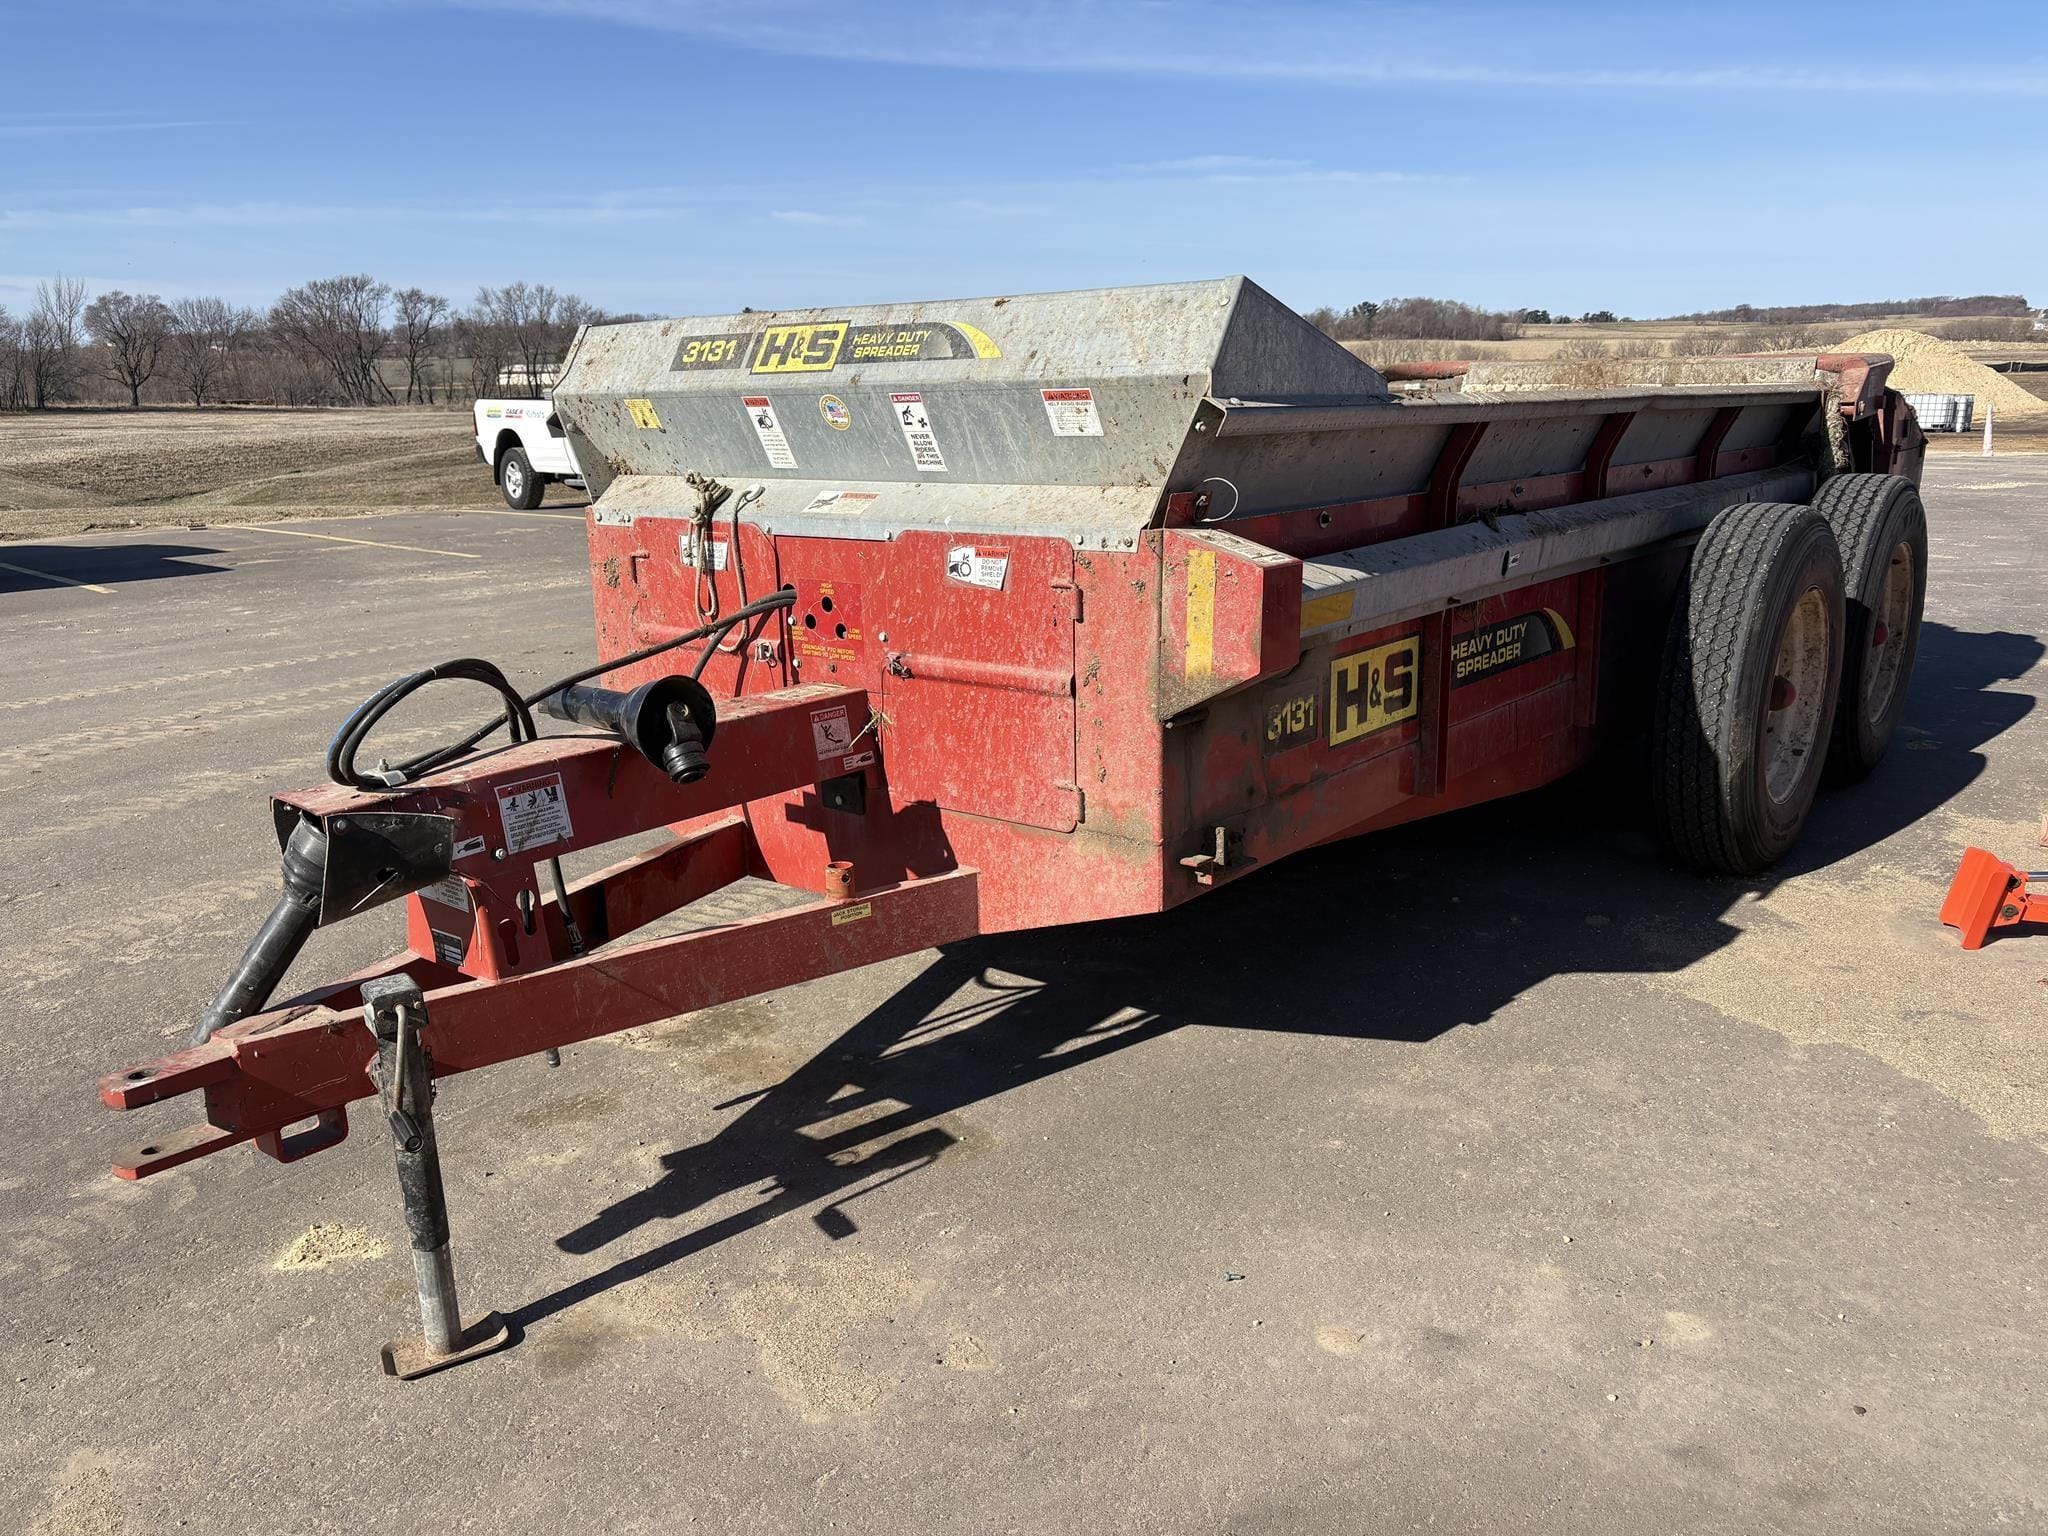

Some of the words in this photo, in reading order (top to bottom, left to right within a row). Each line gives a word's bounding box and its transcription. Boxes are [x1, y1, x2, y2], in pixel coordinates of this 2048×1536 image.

[852, 331, 895, 346] HEAVY
[896, 330, 932, 343] DUTY
[682, 339, 738, 363] 3131
[758, 330, 840, 367] H&S
[853, 344, 921, 358] SPREADER
[1451, 630, 1493, 661] HEAVY
[1496, 621, 1528, 647] DUTY
[1456, 642, 1521, 679] SPREADER
[1335, 647, 1414, 734] H&S
[820, 709, 846, 720] DANGER
[1267, 693, 1315, 741] 3131
[513, 780, 552, 793] WARNING
[832, 910, 846, 918] JACK
[847, 903, 869, 914] STORAGE
[840, 910, 863, 920] POSITION
